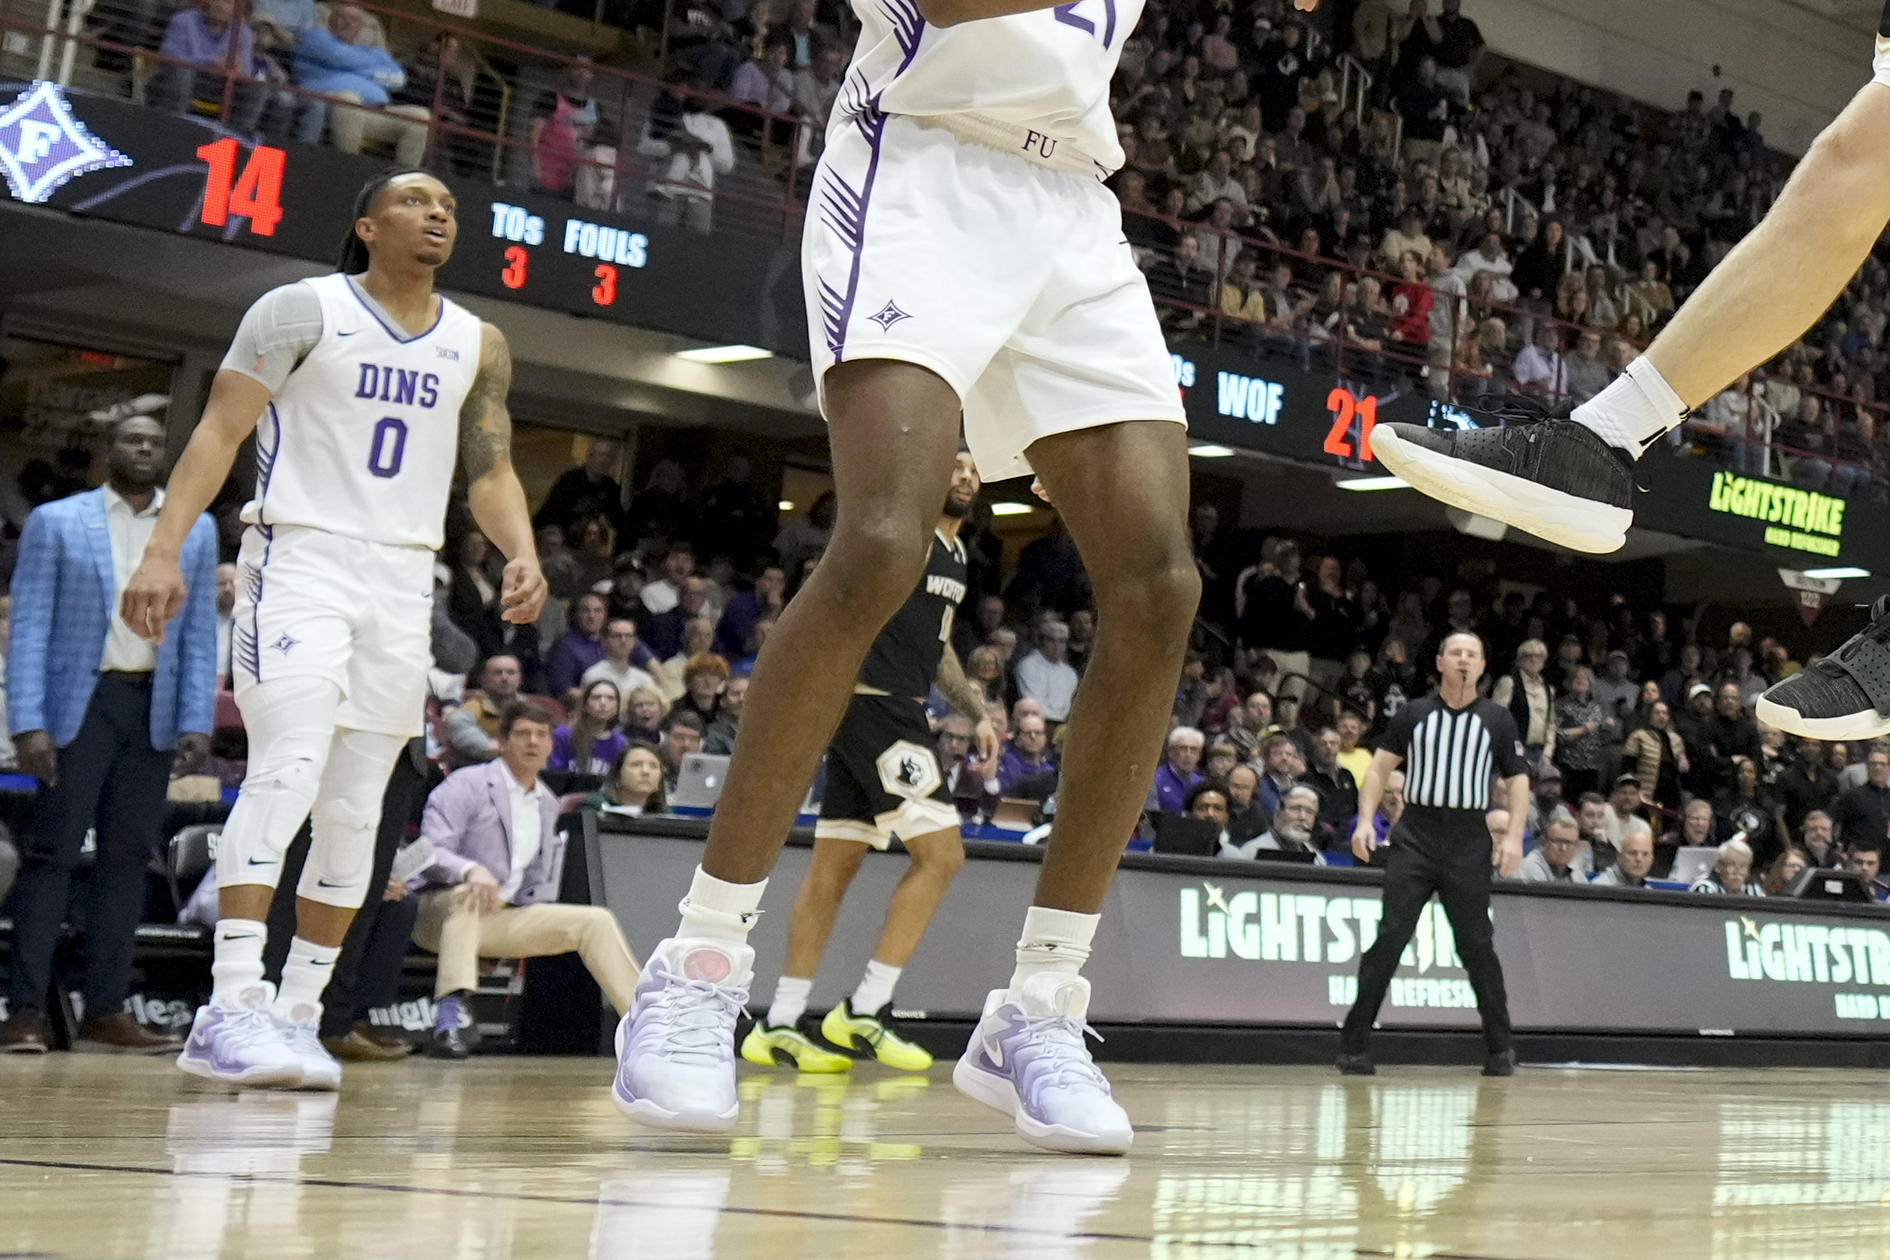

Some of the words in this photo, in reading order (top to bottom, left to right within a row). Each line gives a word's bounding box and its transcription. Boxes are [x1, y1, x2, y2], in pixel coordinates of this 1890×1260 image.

[1021, 128, 1058, 169] FU
[196, 137, 287, 237] 14
[491, 202, 546, 246] TOs
[563, 219, 649, 268] FOULS
[502, 245, 530, 289] 3
[592, 263, 619, 306] 3
[354, 362, 440, 409] DINS
[1217, 370, 1275, 426] WOF
[1323, 387, 1377, 462] 21
[367, 416, 408, 479] 0
[1834, 994, 1879, 1019] HARD
